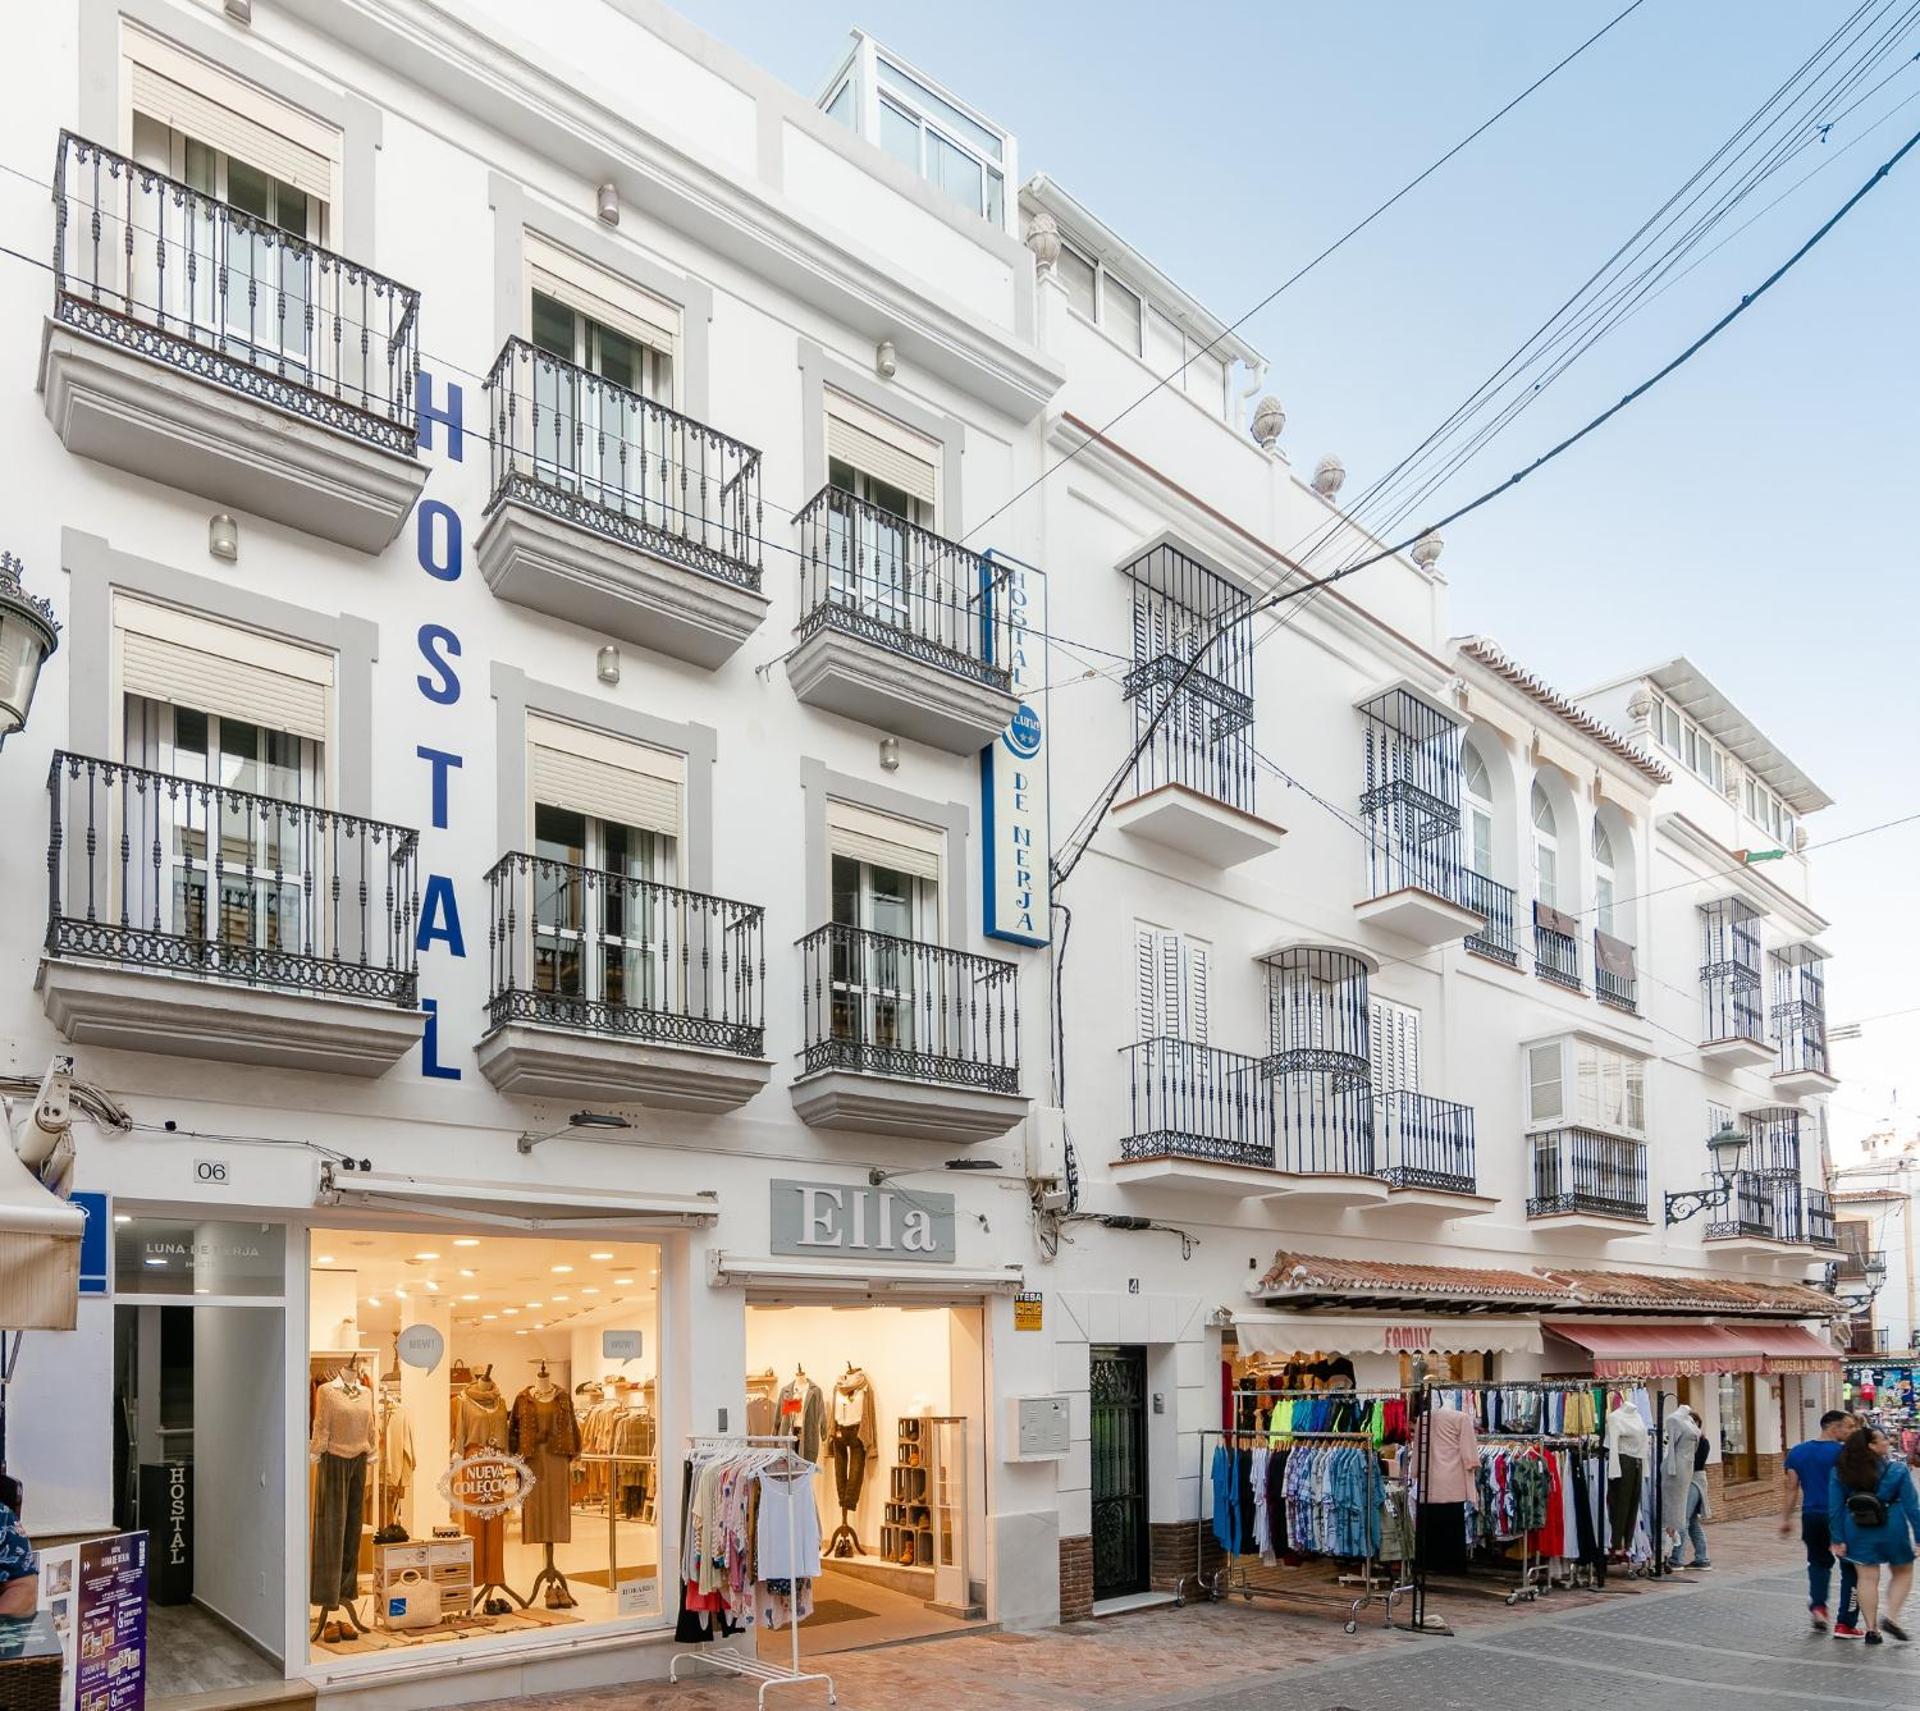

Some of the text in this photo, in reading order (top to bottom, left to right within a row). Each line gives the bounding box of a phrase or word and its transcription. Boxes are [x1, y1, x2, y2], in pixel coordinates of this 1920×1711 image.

[1010, 572, 1028, 687] HOSTAL
[415, 369, 466, 1081] HOSTAL
[1013, 772, 1034, 932] DE NERJA
[198, 1162, 226, 1180] 06
[796, 1186, 937, 1252] Ella
[146, 1243, 185, 1254] LUNA
[1129, 1279, 1139, 1295] 4
[1385, 1327, 1432, 1349] FAMILY
[1618, 1359, 1700, 1375] LIQUOR STORE
[466, 1465, 506, 1480] NUEVA
[170, 1467, 185, 1565] HOSTAL
